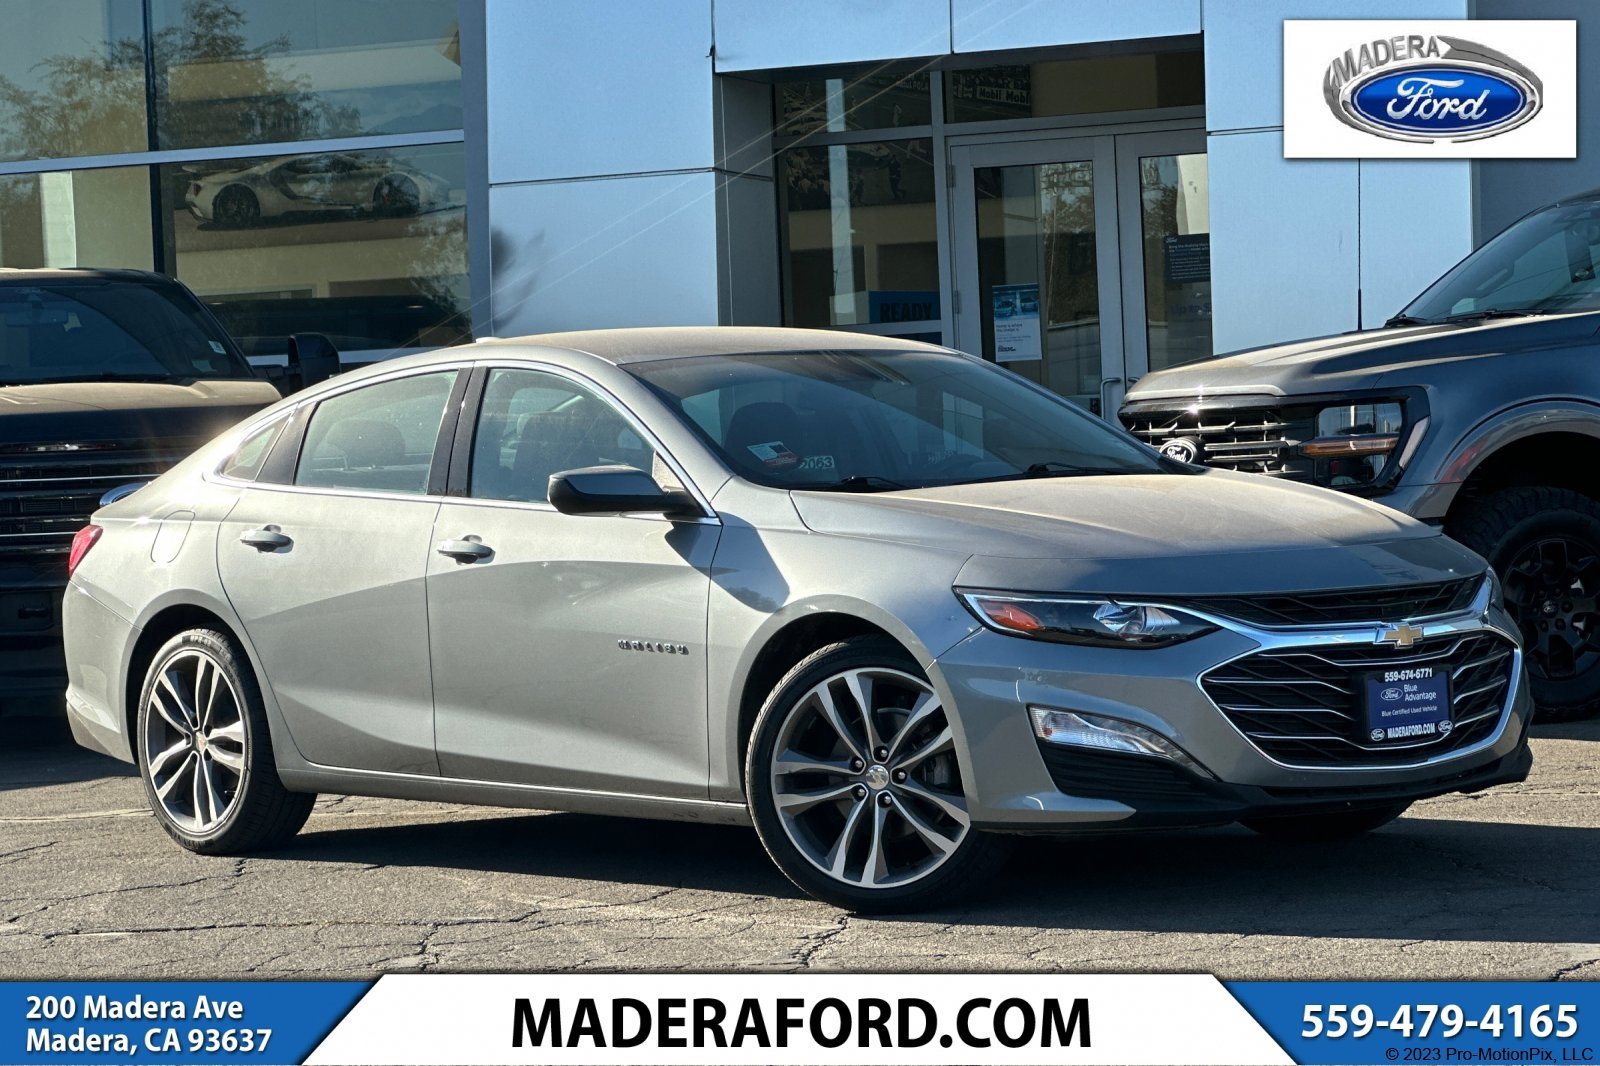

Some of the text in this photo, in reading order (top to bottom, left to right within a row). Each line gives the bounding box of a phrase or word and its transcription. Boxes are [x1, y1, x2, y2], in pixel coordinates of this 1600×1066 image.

[880, 303, 933, 322] READY
[1404, 684, 1418, 692] Blue
[1384, 689, 1399, 699] Ford
[1404, 692, 1436, 702] Advantage
[1392, 708, 1410, 716] Certified
[1387, 723, 1436, 738] MADERAFORD.COM
